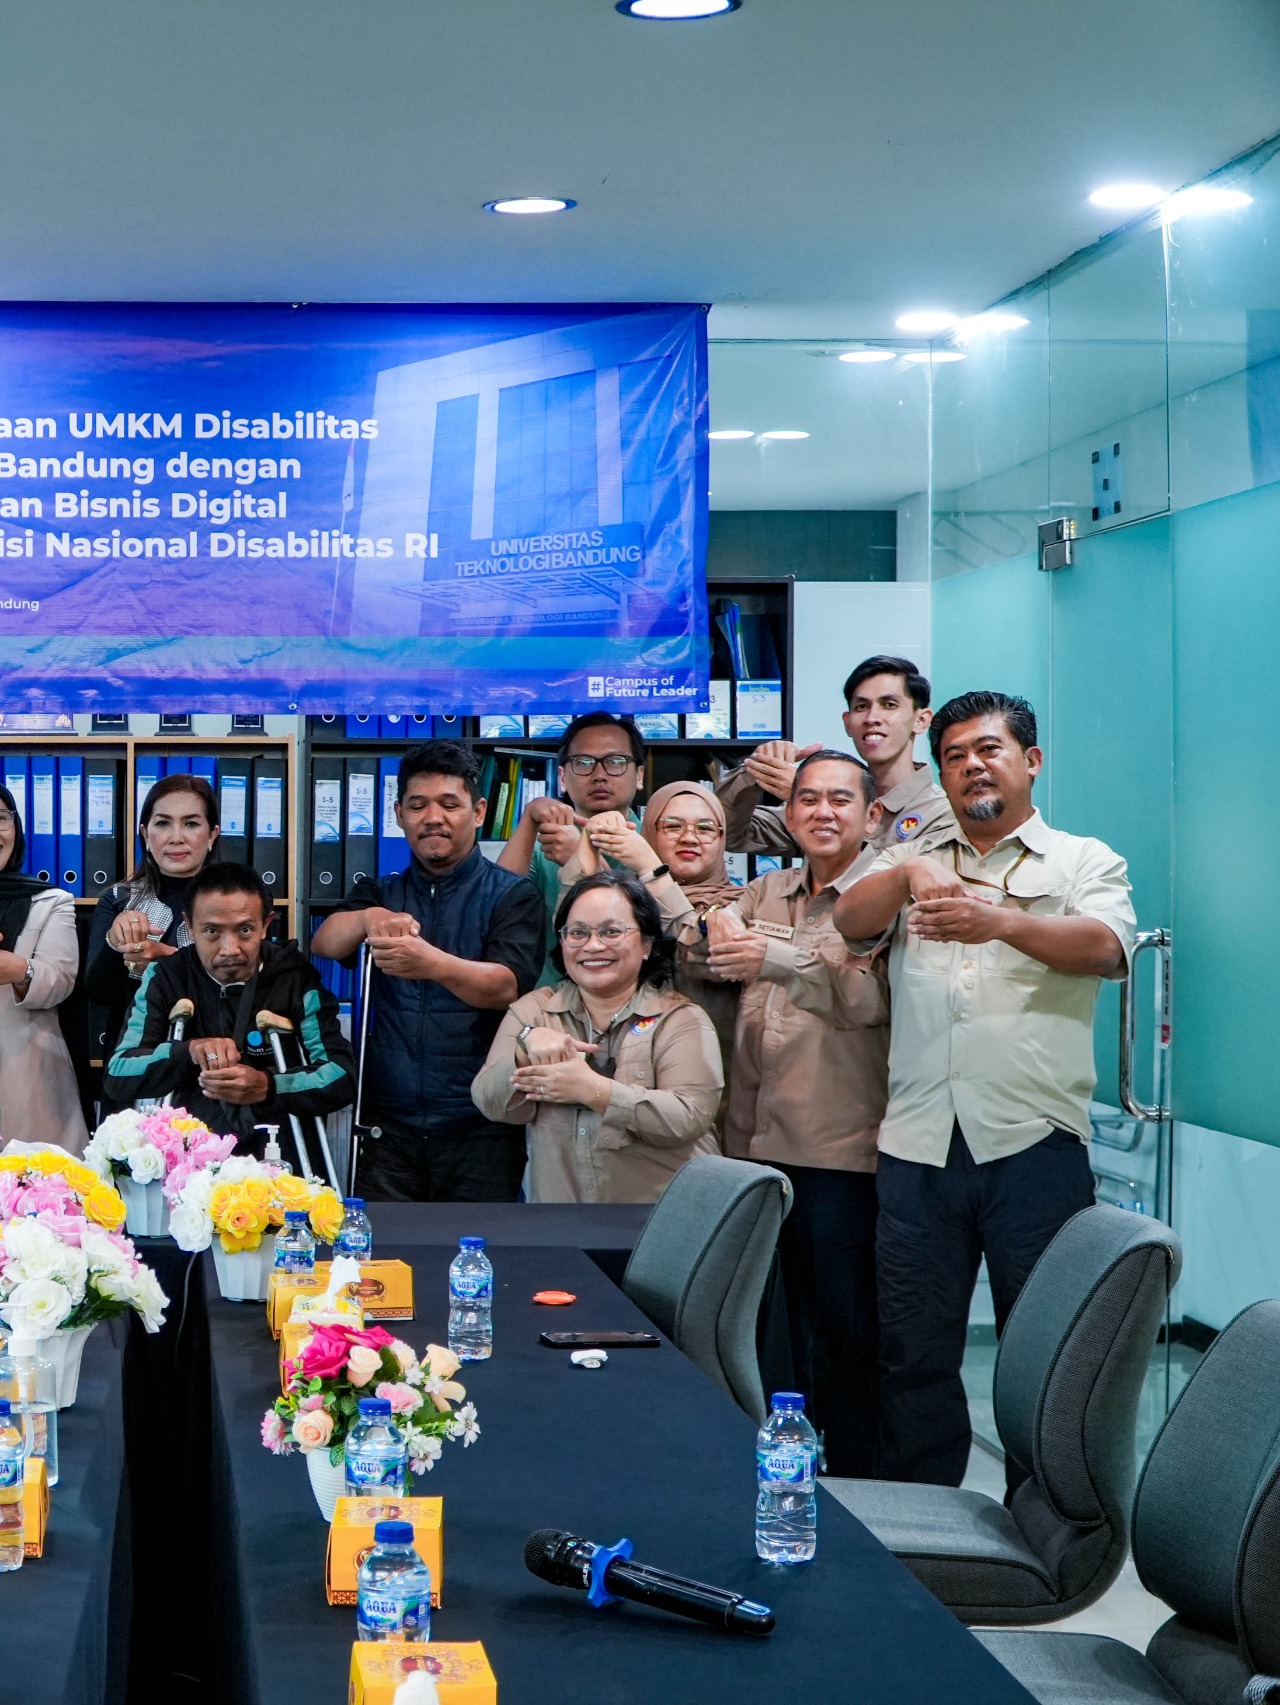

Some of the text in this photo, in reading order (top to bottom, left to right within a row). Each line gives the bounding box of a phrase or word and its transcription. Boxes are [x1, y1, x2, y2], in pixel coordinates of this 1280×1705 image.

[69, 412, 182, 438] UMKM
[195, 410, 379, 440] Disabilitas
[166, 451, 301, 485] dengan
[54, 489, 161, 518] Bisnis
[171, 489, 287, 523] Digital
[45, 529, 198, 558] Nasional
[210, 529, 394, 559] Disabilitas
[406, 533, 439, 558] RI
[491, 529, 604, 557] UNIVERSITAS
[455, 545, 641, 578] TEKNOLOGI BANDUNG
[605, 676, 675, 690] Campus of
[605, 686, 698, 697] Future Leader
[757, 924, 790, 935] SETIAWAN
[348, 1236, 367, 1246] AQUA
[456, 1280, 477, 1290] AQUA
[353, 1461, 381, 1475] AQUA
[767, 1458, 796, 1472] AQUA
[365, 1599, 398, 1616] AQUA
